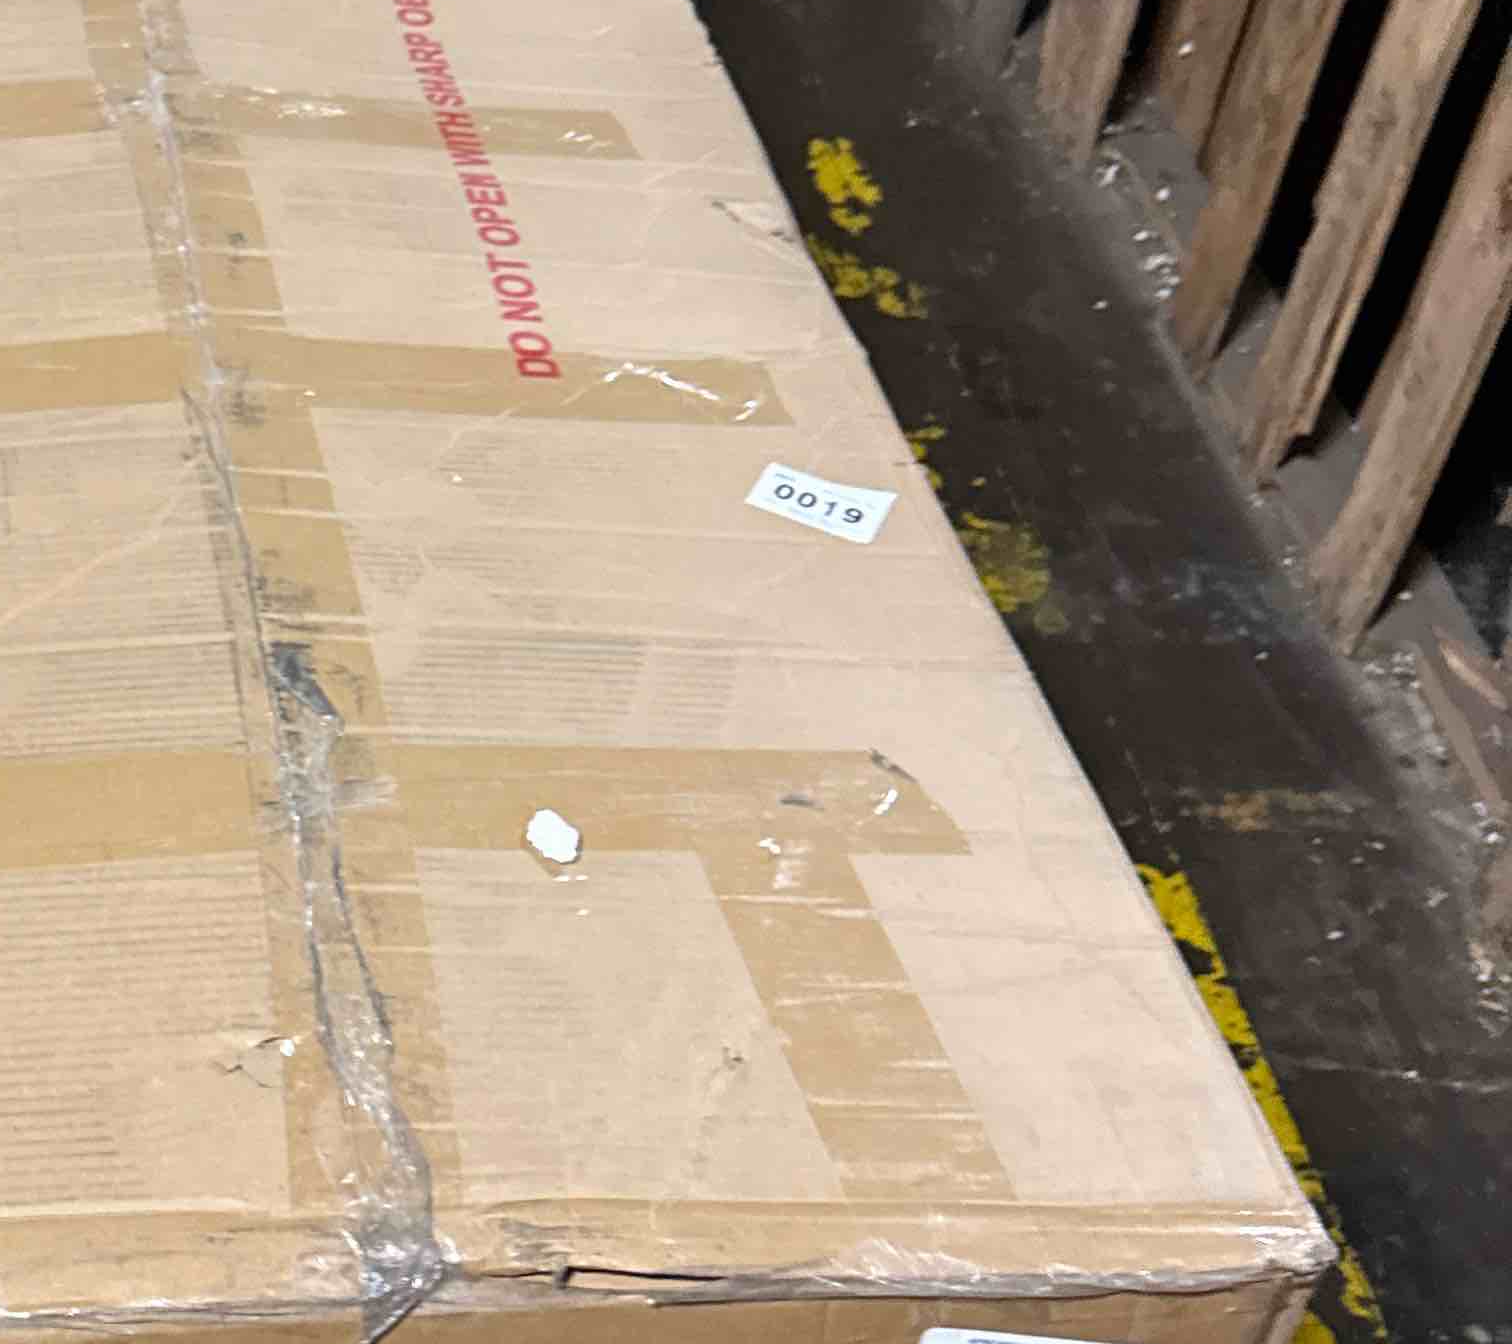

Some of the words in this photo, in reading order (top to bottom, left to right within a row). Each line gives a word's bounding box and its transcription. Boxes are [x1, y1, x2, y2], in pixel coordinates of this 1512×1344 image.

[403, 31, 465, 109] SHARP
[436, 110, 492, 169] WITH
[458, 169, 521, 247] OPEN
[487, 254, 544, 323] NOT
[508, 331, 562, 380] DO
[773, 483, 865, 524] 0019
